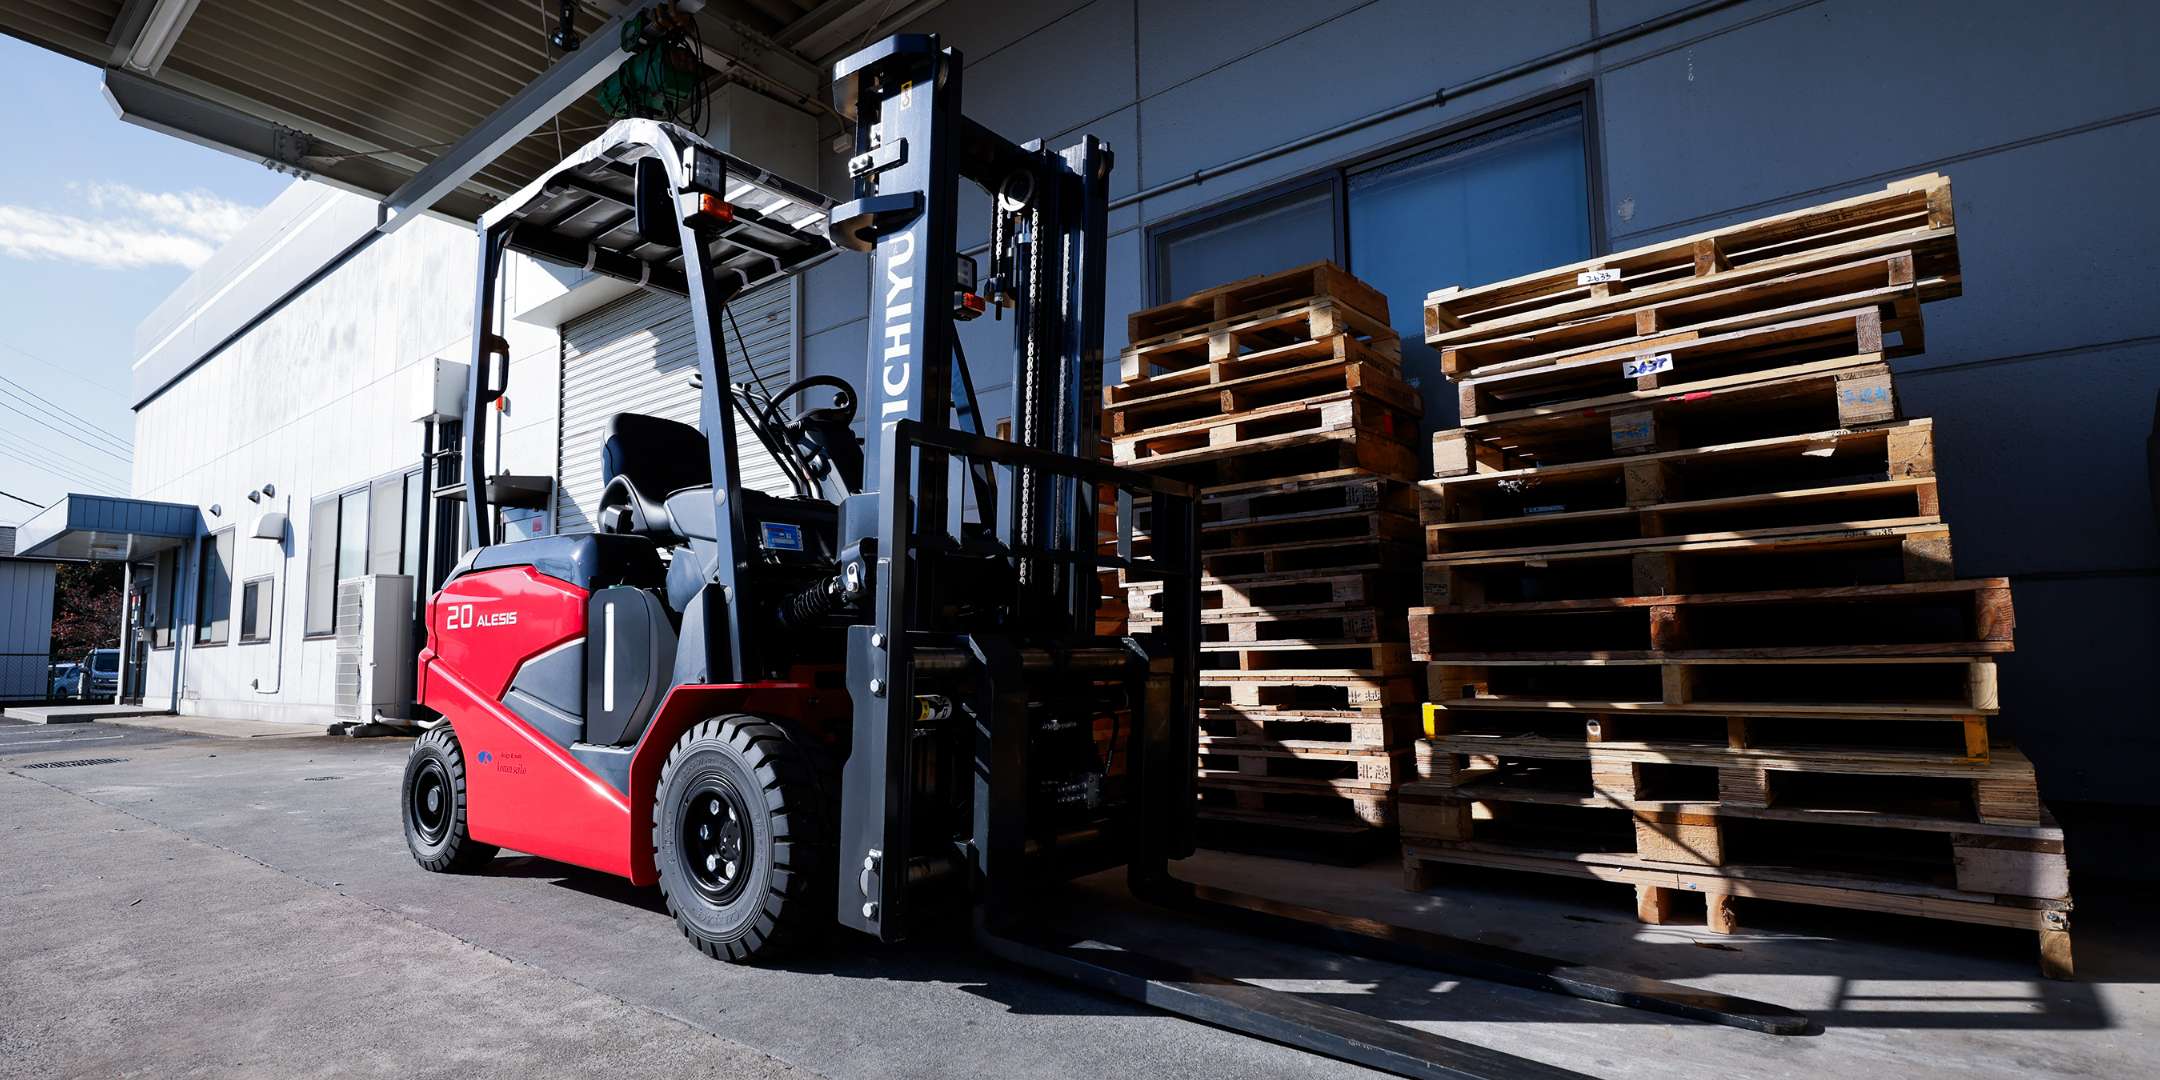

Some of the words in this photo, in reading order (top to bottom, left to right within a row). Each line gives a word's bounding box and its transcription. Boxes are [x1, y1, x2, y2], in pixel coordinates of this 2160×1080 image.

[881, 231, 915, 432] ICHIYU
[447, 604, 473, 630] 20
[476, 612, 517, 627] ALESIS
